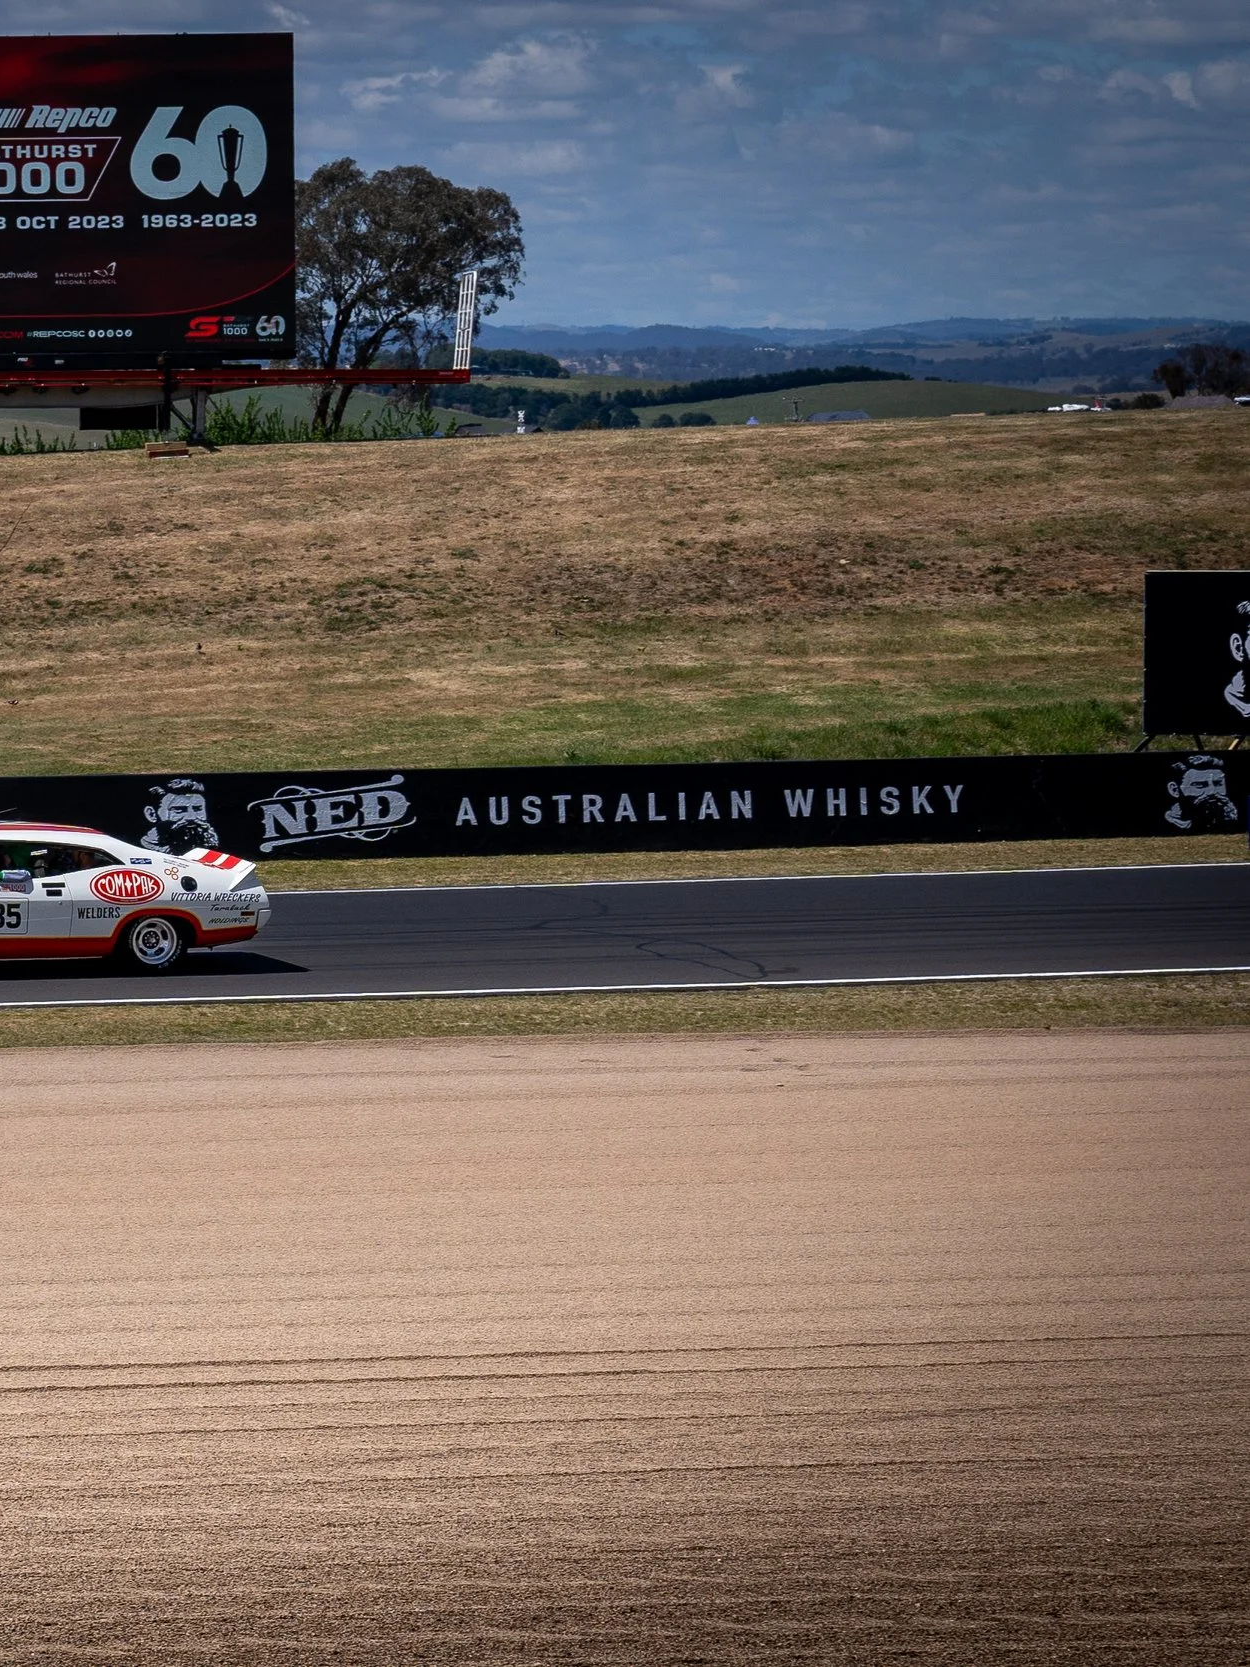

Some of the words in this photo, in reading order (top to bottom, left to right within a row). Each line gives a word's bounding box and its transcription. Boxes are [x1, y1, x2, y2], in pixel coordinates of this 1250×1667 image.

[25, 105, 118, 133] Repco
[130, 105, 268, 201] 60
[16, 216, 59, 230] OCT
[68, 215, 124, 229] 2023
[141, 213, 257, 228] 1963-2023
[17, 271, 38, 279] wales
[27, 330, 86, 338] #REPCOSC
[223, 327, 248, 335] 1000
[455, 790, 753, 827] AUSTRALIAN
[784, 784, 964, 818] WHISKY
[260, 789, 411, 840] NED
[170, 892, 212, 902] VITTORIA
[214, 892, 262, 903] WRECKERS
[77, 906, 121, 920] WELDERS
